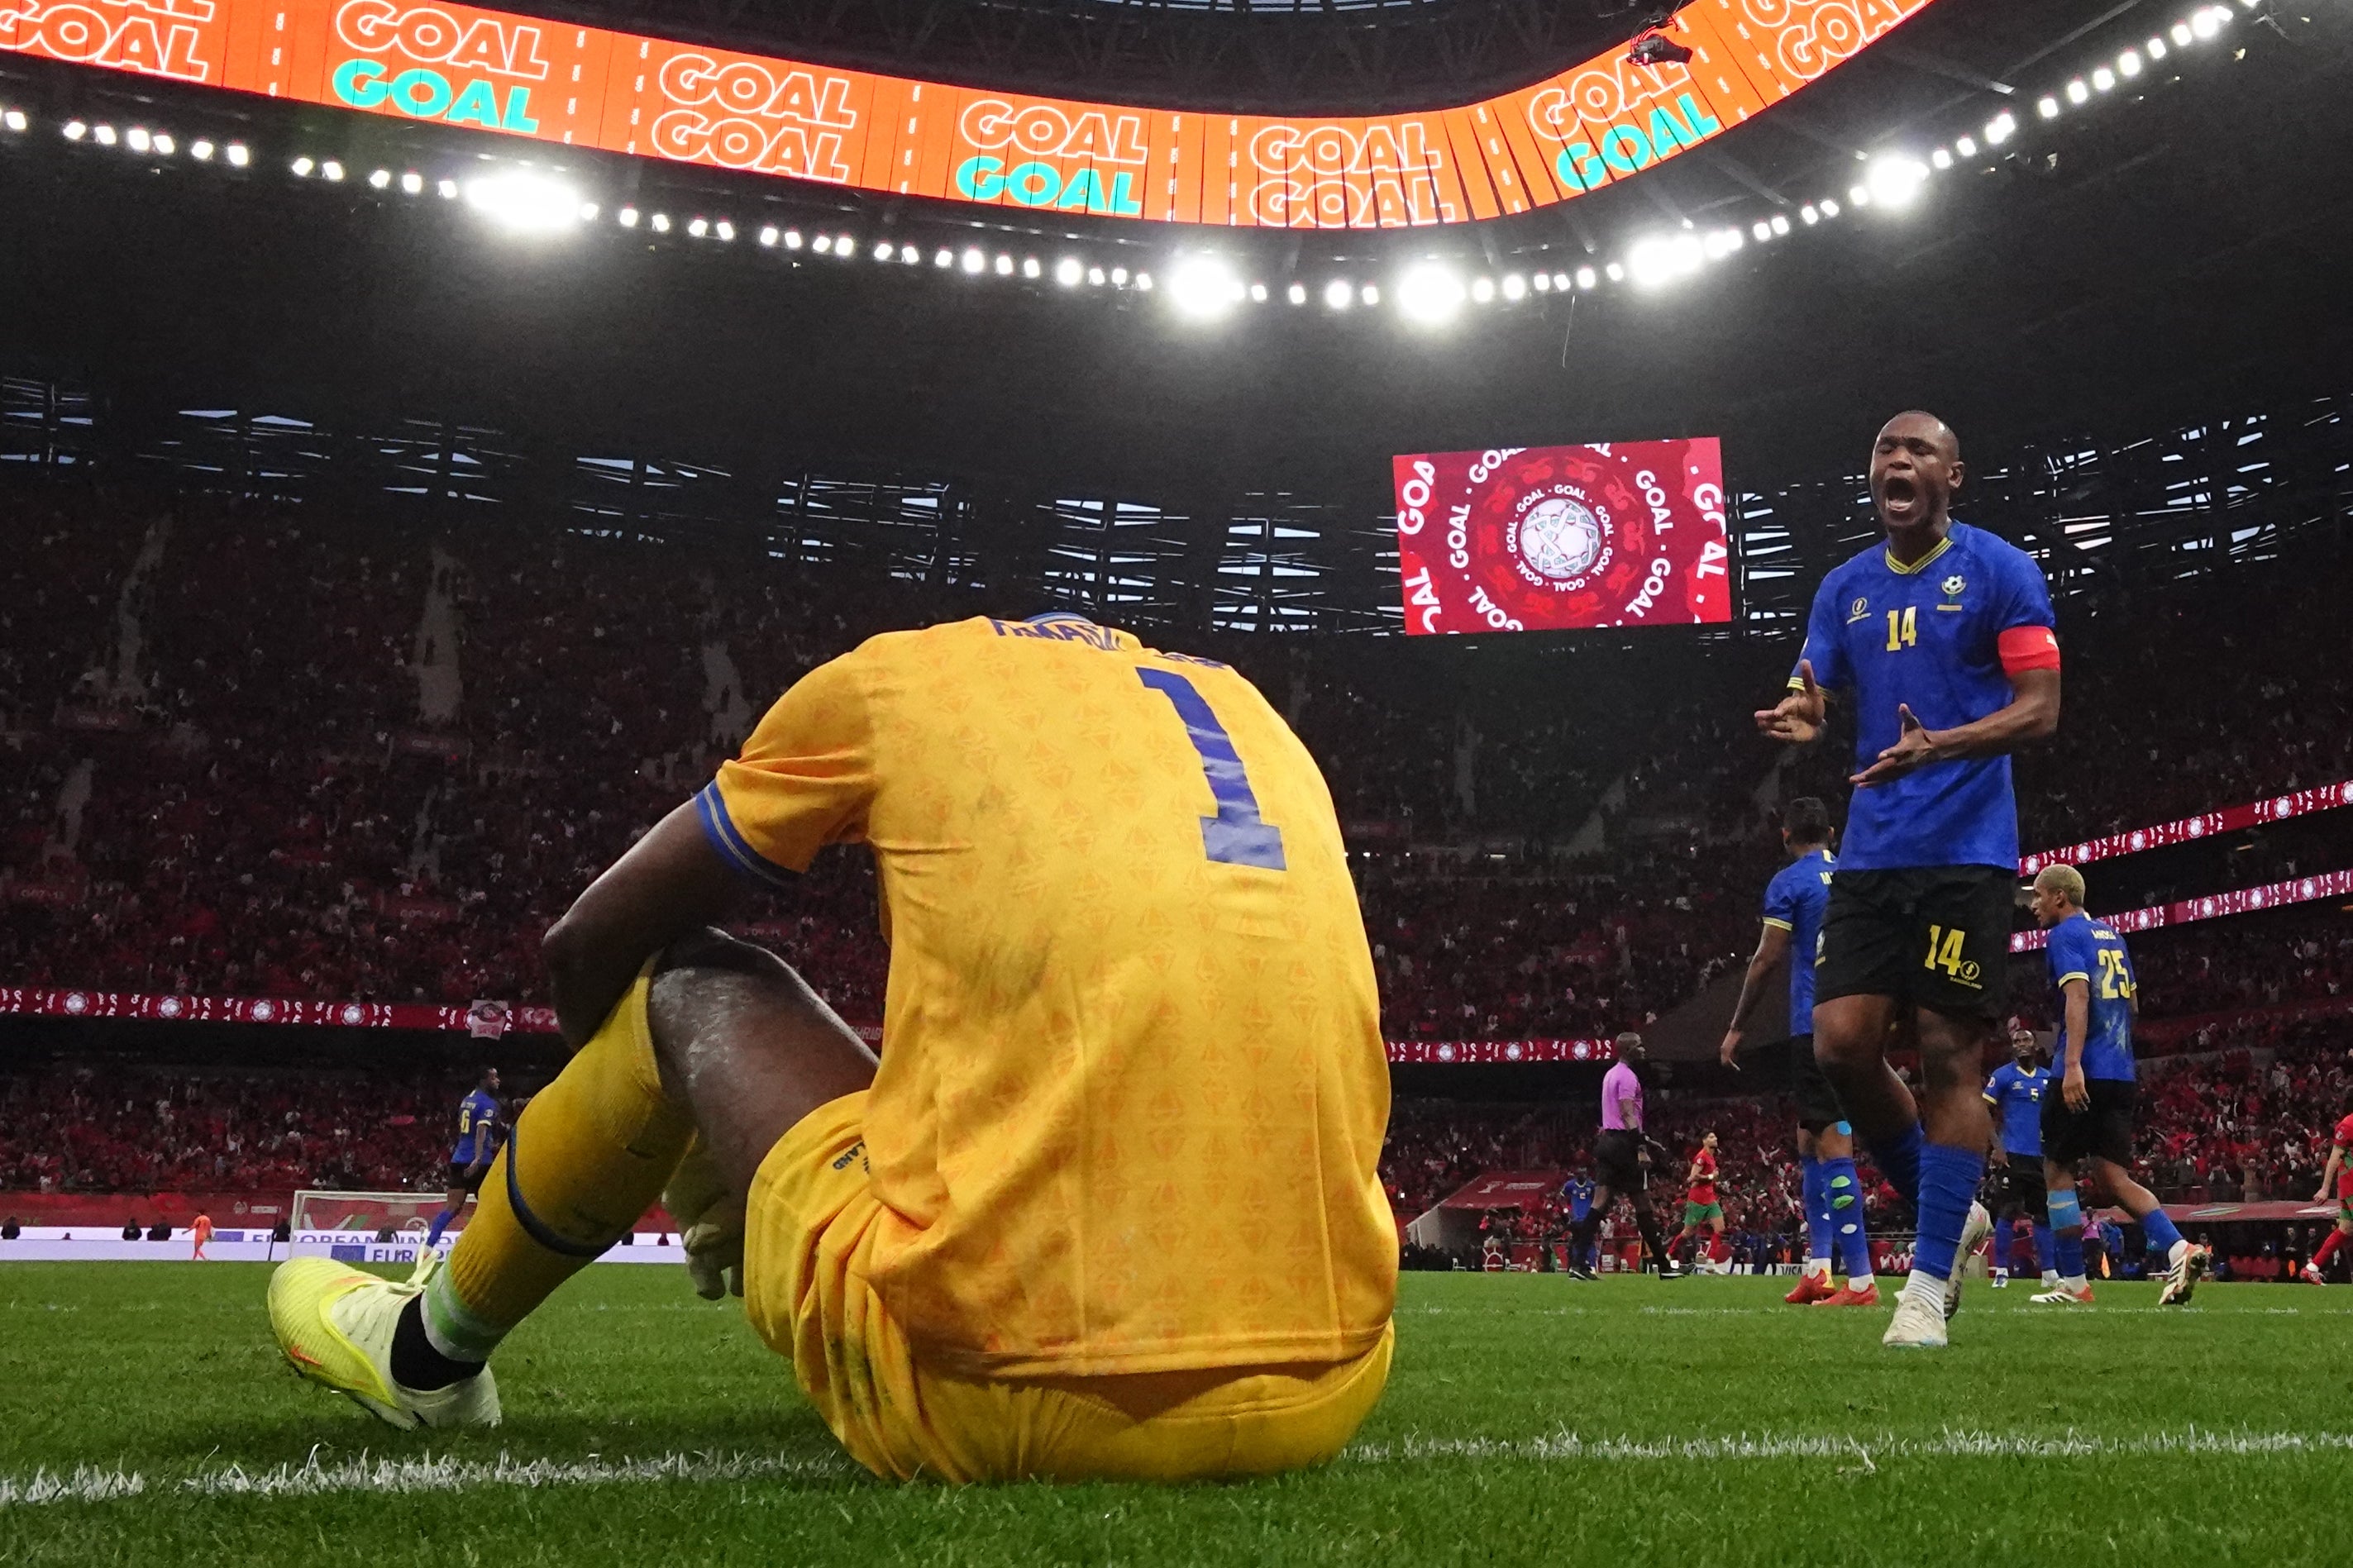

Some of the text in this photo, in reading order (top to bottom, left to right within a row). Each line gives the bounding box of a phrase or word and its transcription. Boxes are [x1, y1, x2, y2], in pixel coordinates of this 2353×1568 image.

[336, 0, 549, 79] GOAL
[332, 58, 538, 134] GOAL
[660, 53, 857, 128] GOAL
[1530, 50, 1691, 141] GOAL
[651, 109, 849, 182] GOAL
[961, 99, 1148, 163] GOAL
[1250, 122, 1442, 174] GOAL
[1557, 93, 1720, 191] GOAL
[956, 155, 1142, 216] GOAL
[1250, 176, 1455, 227] GOAL
[1516, 489, 1545, 512] GOAL
[1554, 484, 1585, 500] GOAL
[1636, 470, 1673, 535] GOAL
[1448, 504, 1471, 569] GOAL
[1506, 521, 1518, 553] GOAL
[1596, 505, 1614, 536] GOAL
[1516, 560, 1544, 586] GOAL
[1554, 577, 1585, 592] GOAL
[1591, 547, 1613, 576] GOAL
[1625, 558, 1671, 617] GOAL
[1468, 585, 1523, 631] GOAL
[1886, 606, 1917, 652] 14
[1135, 667, 1287, 870] 1
[1924, 924, 1965, 976] 14
[2097, 949, 2131, 999] 25
[2031, 1088, 2039, 1102] 5
